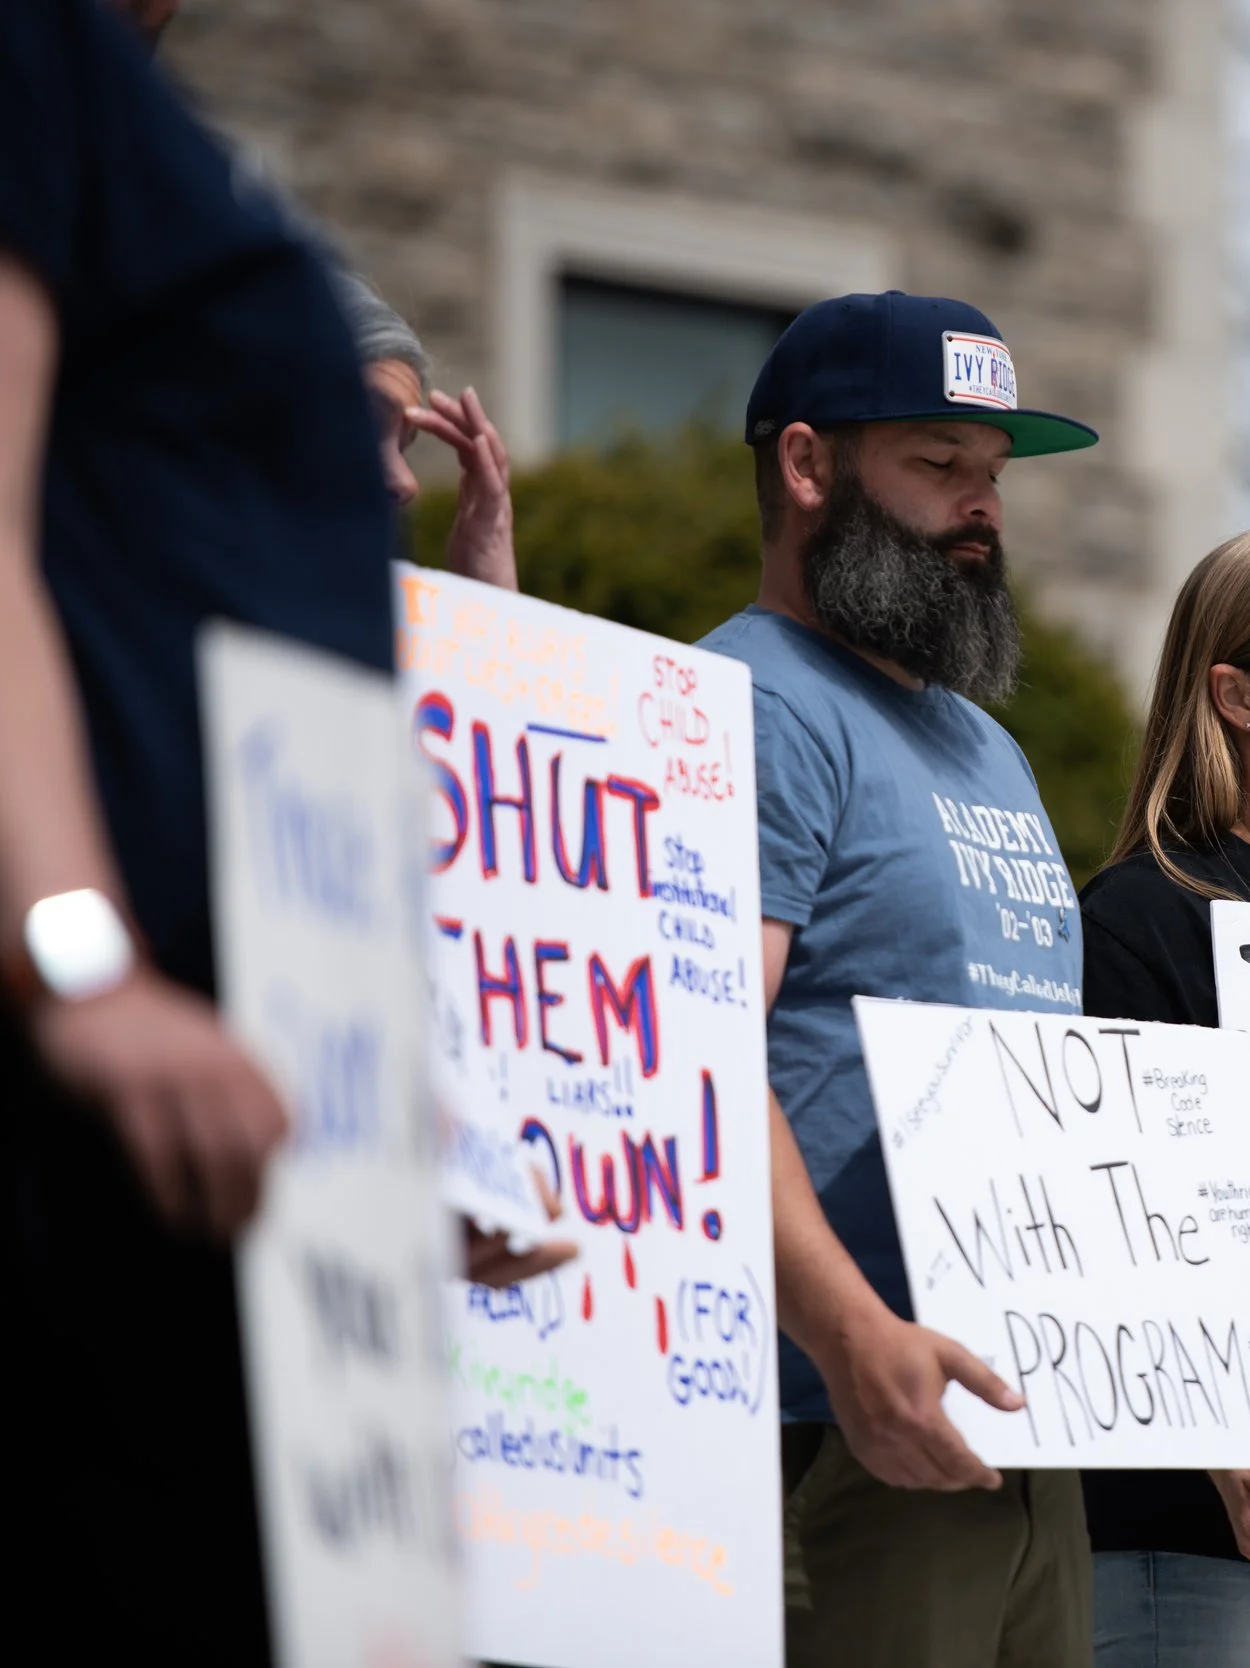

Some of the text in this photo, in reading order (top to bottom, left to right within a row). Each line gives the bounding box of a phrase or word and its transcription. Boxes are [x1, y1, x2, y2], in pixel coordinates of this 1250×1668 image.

[953, 351, 985, 384] IVY
[990, 357, 1016, 399] RIDGE
[652, 654, 699, 697] STOP
[637, 691, 711, 750] CHILD
[414, 689, 662, 900] SHUT
[663, 730, 736, 803] ABUSE!
[931, 791, 1054, 856] ACADEMY
[948, 839, 1076, 910] IVY RIDGE
[656, 909, 717, 951] CHILD
[669, 953, 749, 1010] ABUSE!
[989, 1020, 1143, 1138] NOT
[1142, 1067, 1209, 1096] #Breaking
[1170, 1091, 1203, 1112] Code
[933, 1160, 1211, 1289] With The
